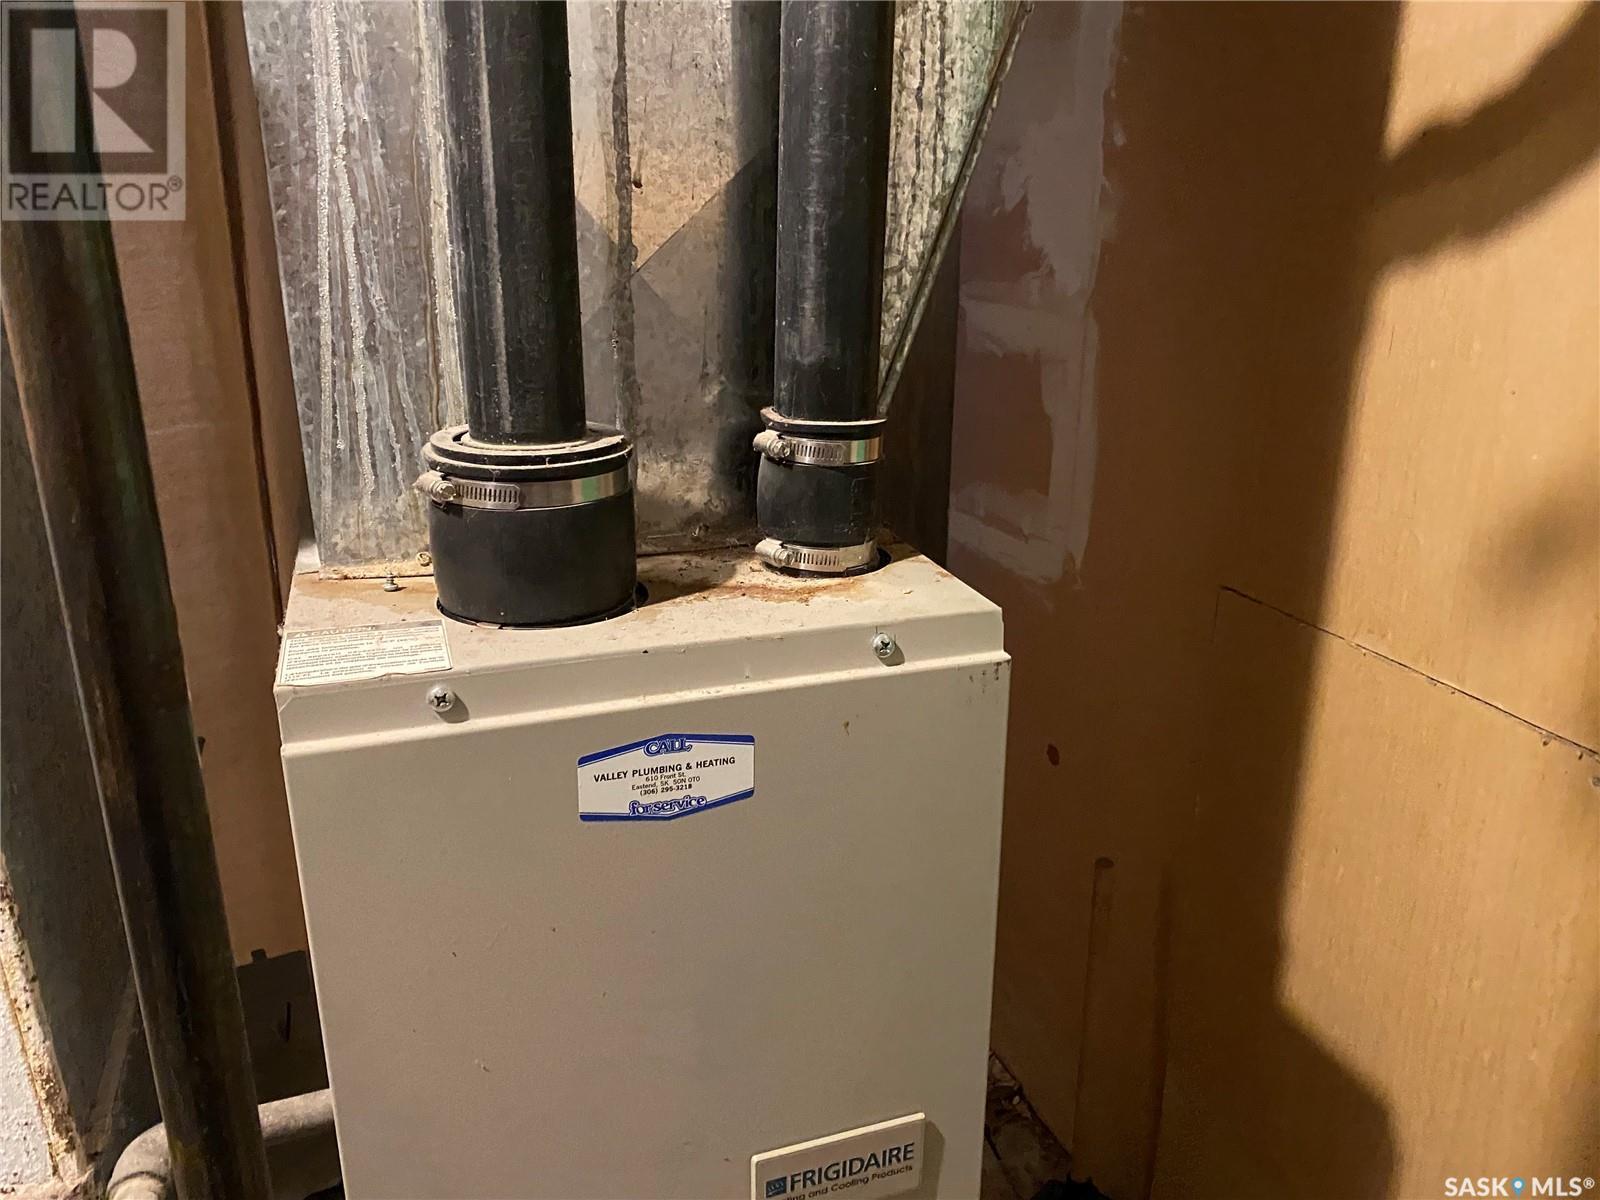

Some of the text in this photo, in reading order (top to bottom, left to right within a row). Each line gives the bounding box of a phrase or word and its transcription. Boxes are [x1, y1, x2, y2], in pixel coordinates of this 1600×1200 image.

[644, 738, 692, 756] CALL
[594, 756, 736, 783] VALLEY PLUMBING & HEATING
[660, 772, 677, 780] Front
[640, 784, 693, 797] (306) 295-3218
[629, 795, 706, 815] for service
[790, 1142, 915, 1192] FRIGIDAIRE
[808, 1187, 828, 1198] and
[831, 1177, 869, 1191] Cooling
[871, 1166, 913, 1180] Products
